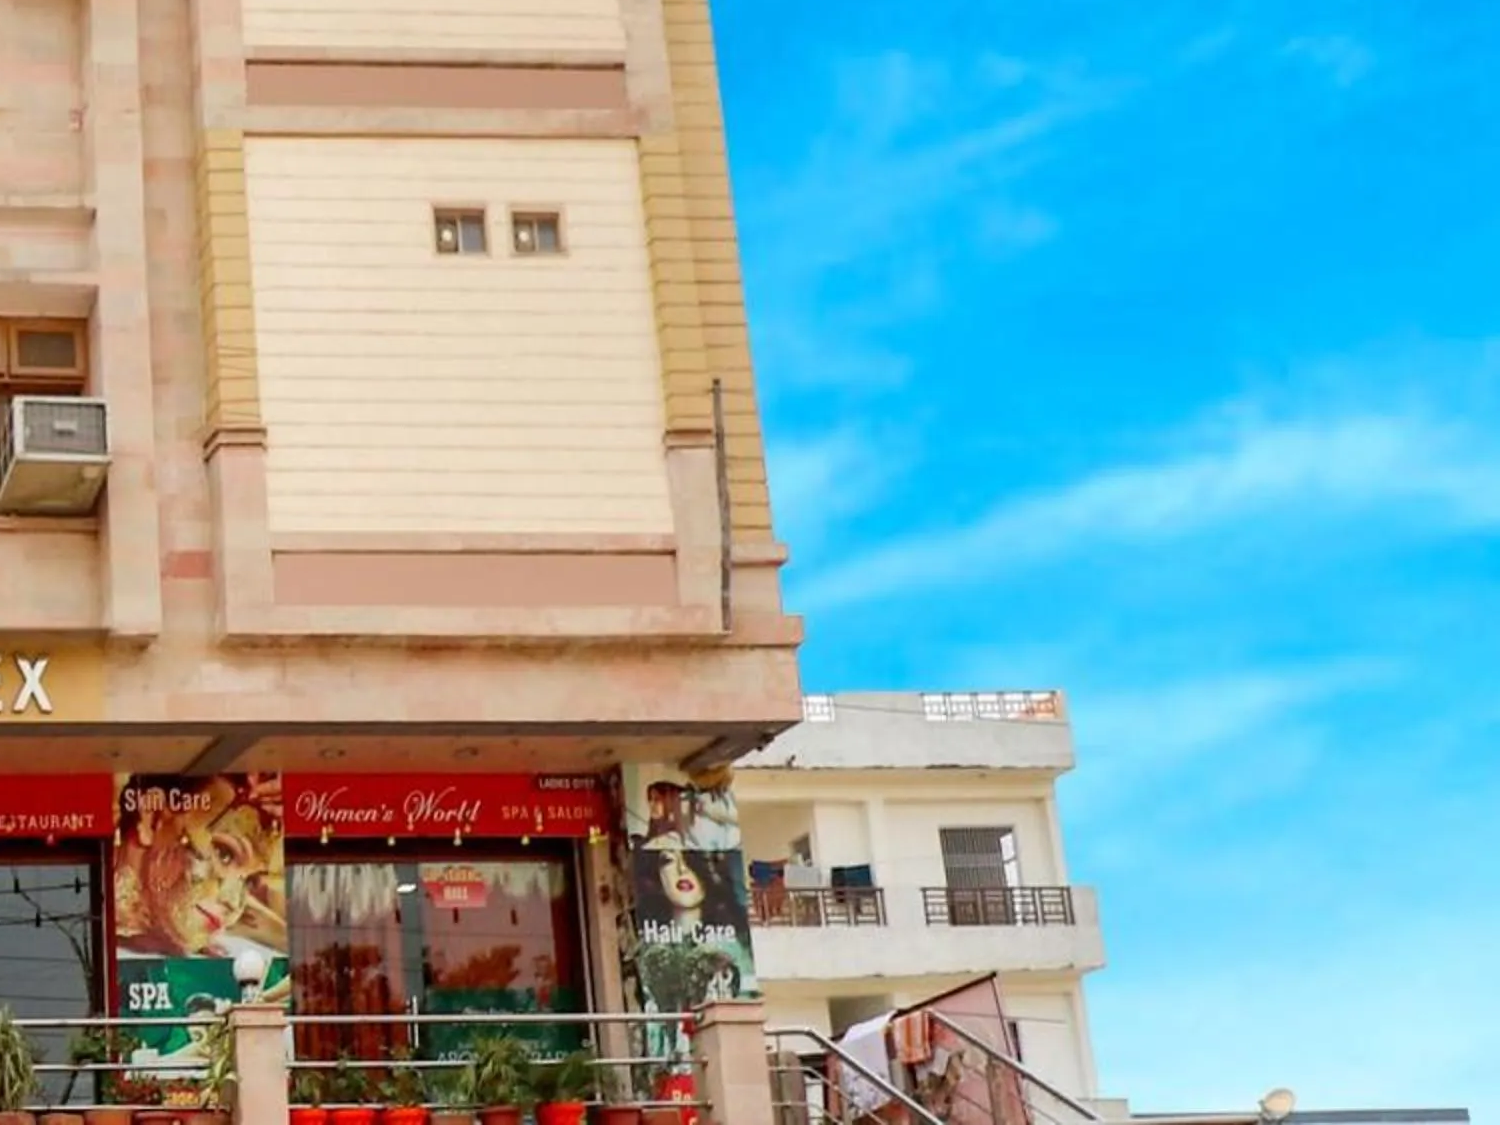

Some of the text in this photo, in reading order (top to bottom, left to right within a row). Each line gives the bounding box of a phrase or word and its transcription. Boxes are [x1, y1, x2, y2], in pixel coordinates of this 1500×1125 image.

[124, 786, 211, 812] Skin Care
[295, 786, 481, 823] Women's World
[501, 805, 529, 820] SPA
[547, 805, 594, 820] SALON
[643, 920, 737, 944] Hair Care
[129, 982, 173, 1010] SPA
